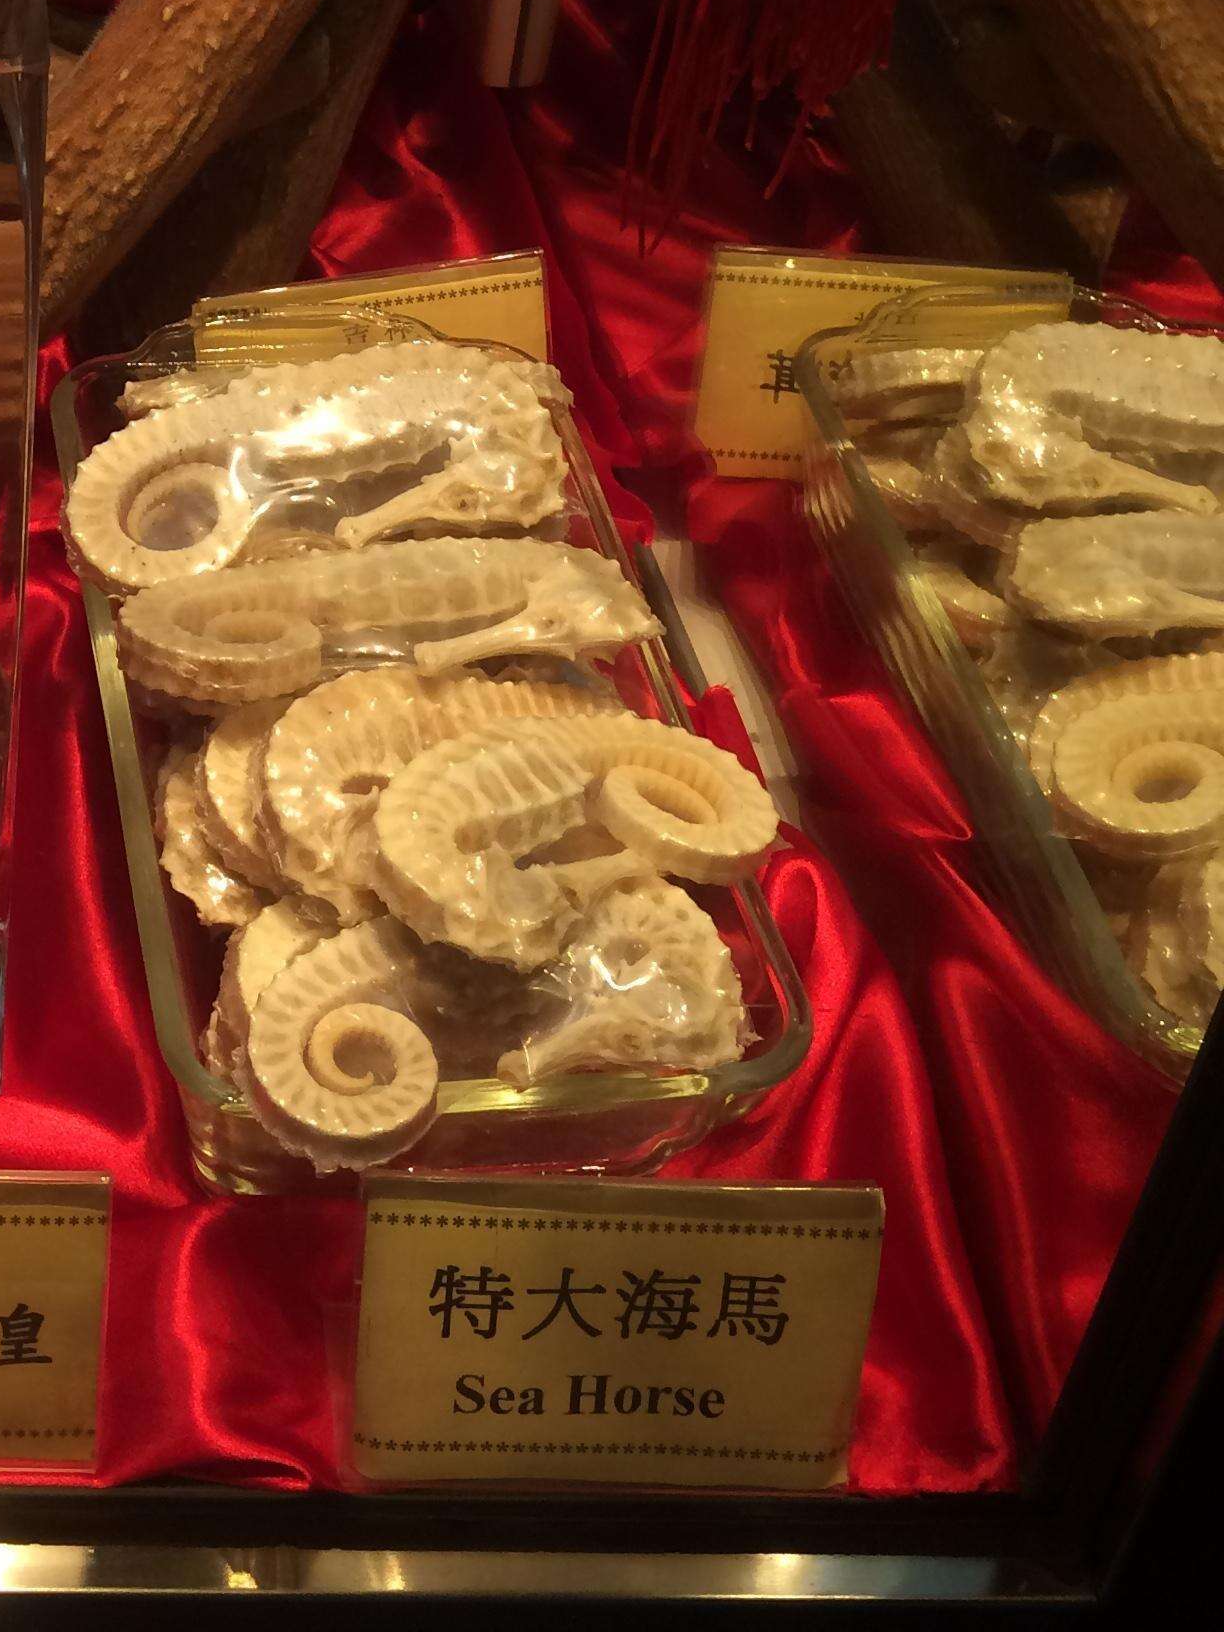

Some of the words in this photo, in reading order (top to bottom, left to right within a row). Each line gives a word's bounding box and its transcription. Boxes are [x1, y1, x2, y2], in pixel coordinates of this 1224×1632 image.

[427, 1263, 791, 1347] 特大海馬
[452, 1373, 546, 1416] Sea
[564, 1373, 728, 1420] Horse
